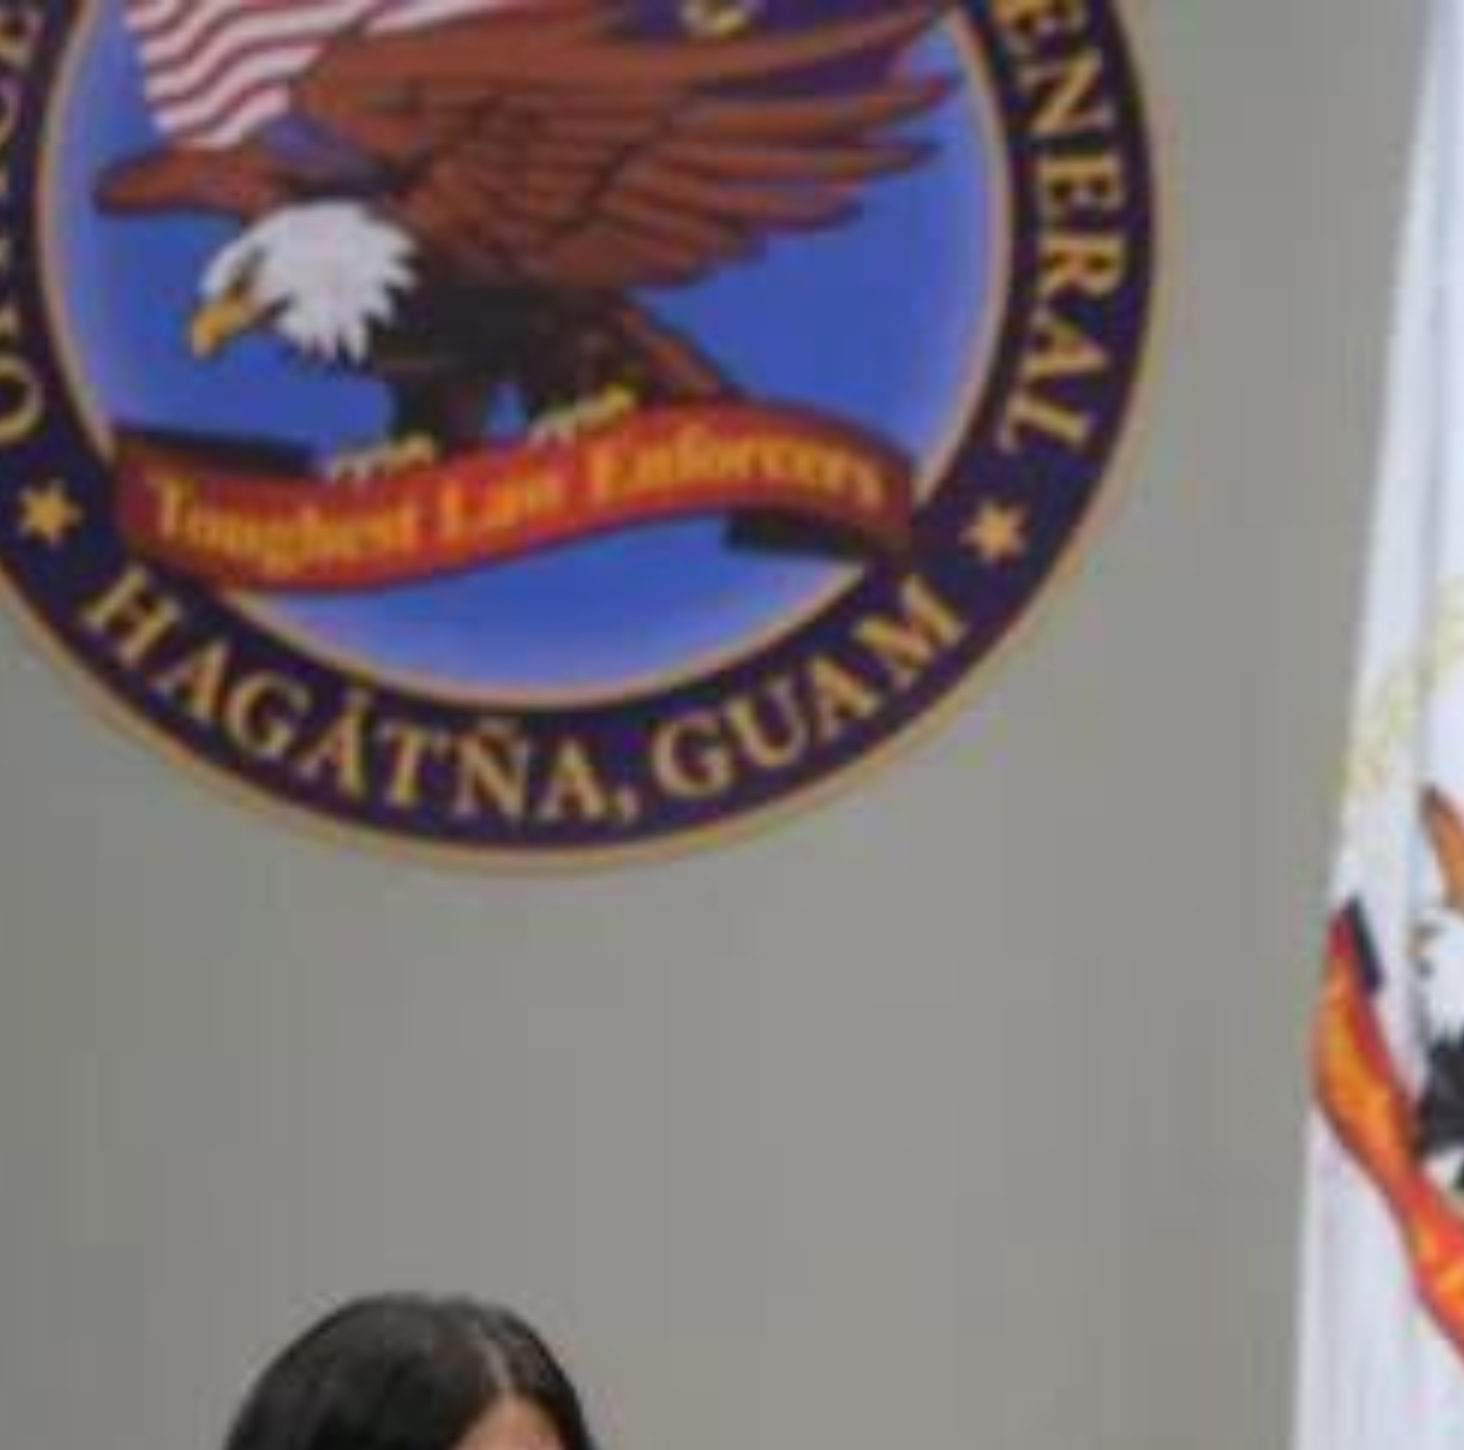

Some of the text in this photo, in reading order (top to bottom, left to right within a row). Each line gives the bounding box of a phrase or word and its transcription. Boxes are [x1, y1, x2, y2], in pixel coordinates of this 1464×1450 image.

[440, 474, 563, 550] Law
[590, 424, 888, 506] Enforcers
[652, 576, 965, 796] GUAM
